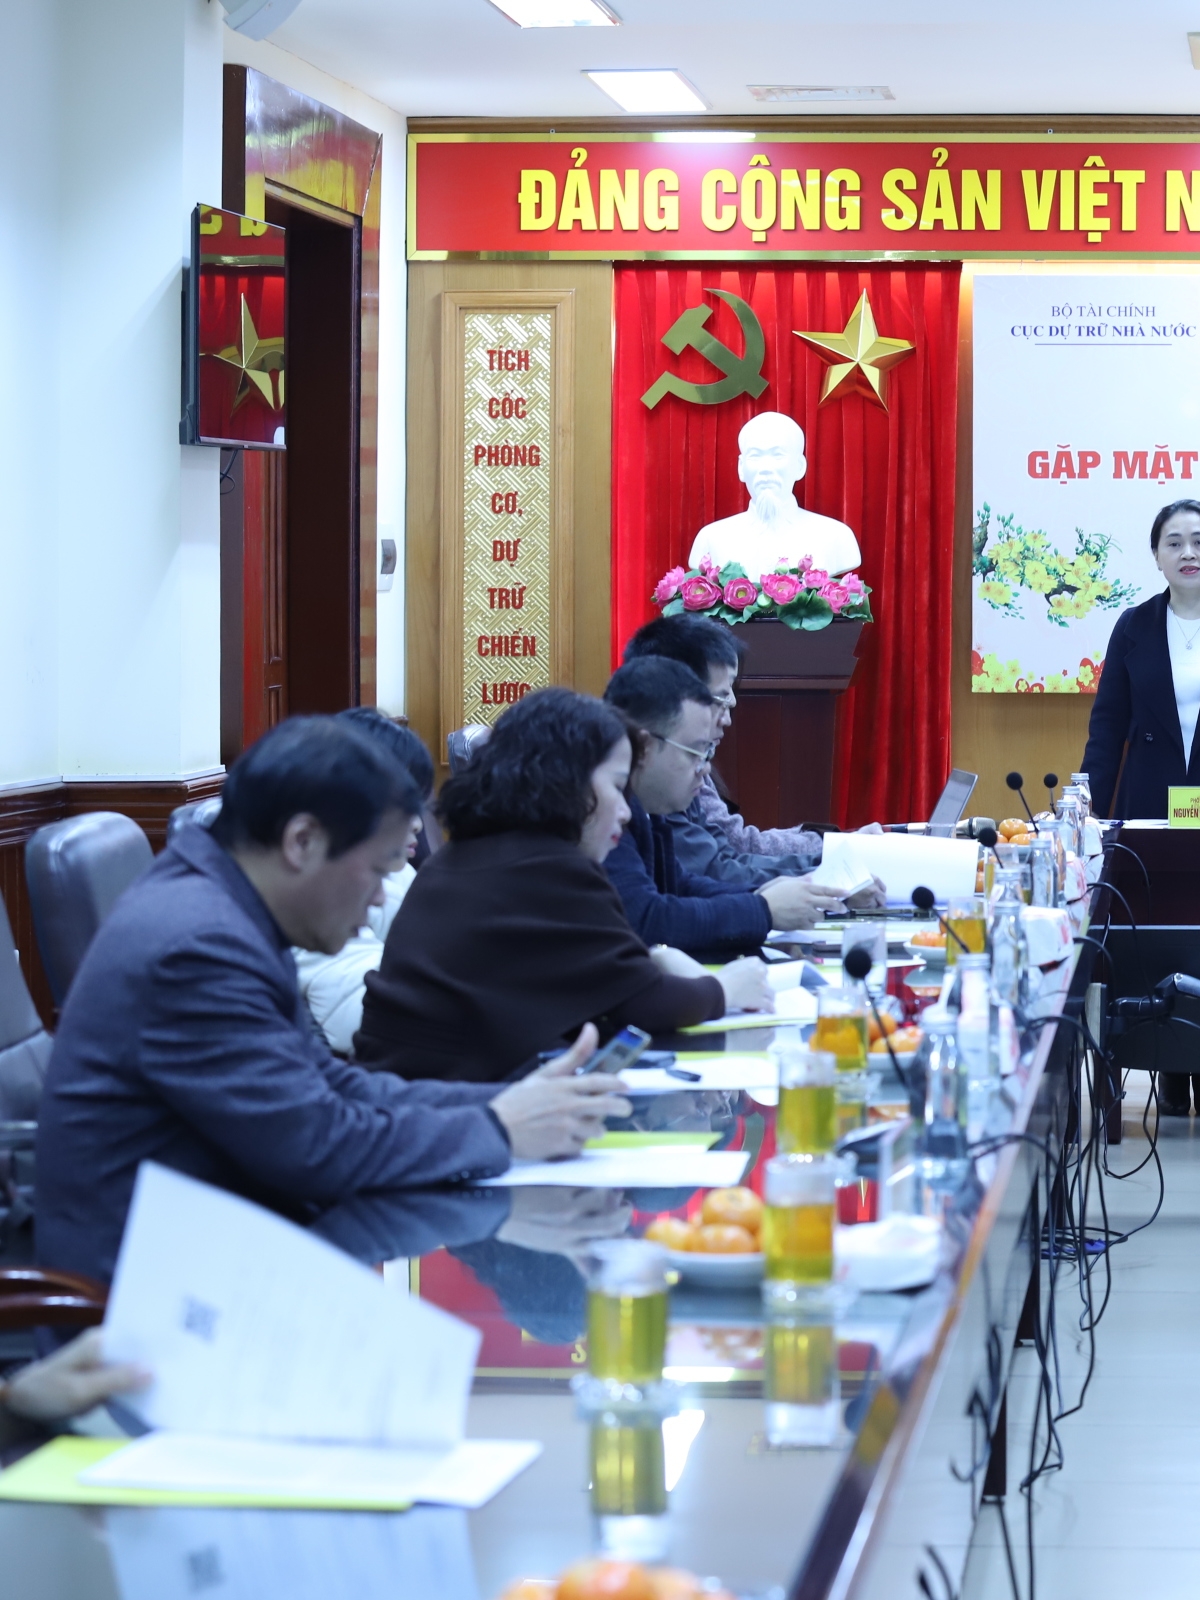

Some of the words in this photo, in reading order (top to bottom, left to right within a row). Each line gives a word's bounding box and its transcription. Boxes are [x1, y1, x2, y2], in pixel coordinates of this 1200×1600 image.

[518, 148, 680, 233] ĐẢNG
[701, 154, 863, 243] CỘNG
[880, 146, 1002, 232] SẢN
[1022, 155, 1145, 243] VIỆT
[1051, 302, 1073, 320] BỘ
[1076, 302, 1103, 317] TÀI
[1106, 302, 1156, 318] CHÍNH
[1010, 325, 1045, 340] CỤC
[1048, 323, 1072, 340] DỰ
[1075, 322, 1109, 338] TRỮ
[1112, 321, 1146, 338] NHÀ
[1150, 322, 1197, 338] NƯỚC
[487, 345, 530, 371] TÍCH
[488, 390, 527, 419] CỐC
[474, 440, 541, 467] PHÒNG
[1027, 445, 1101, 485] GẶP
[1112, 445, 1199, 485] MẶT
[491, 492, 523, 517] CƠ,
[492, 538, 521, 567] DỰ
[487, 582, 526, 609] TRỮ
[477, 628, 536, 657] CHIẾN
